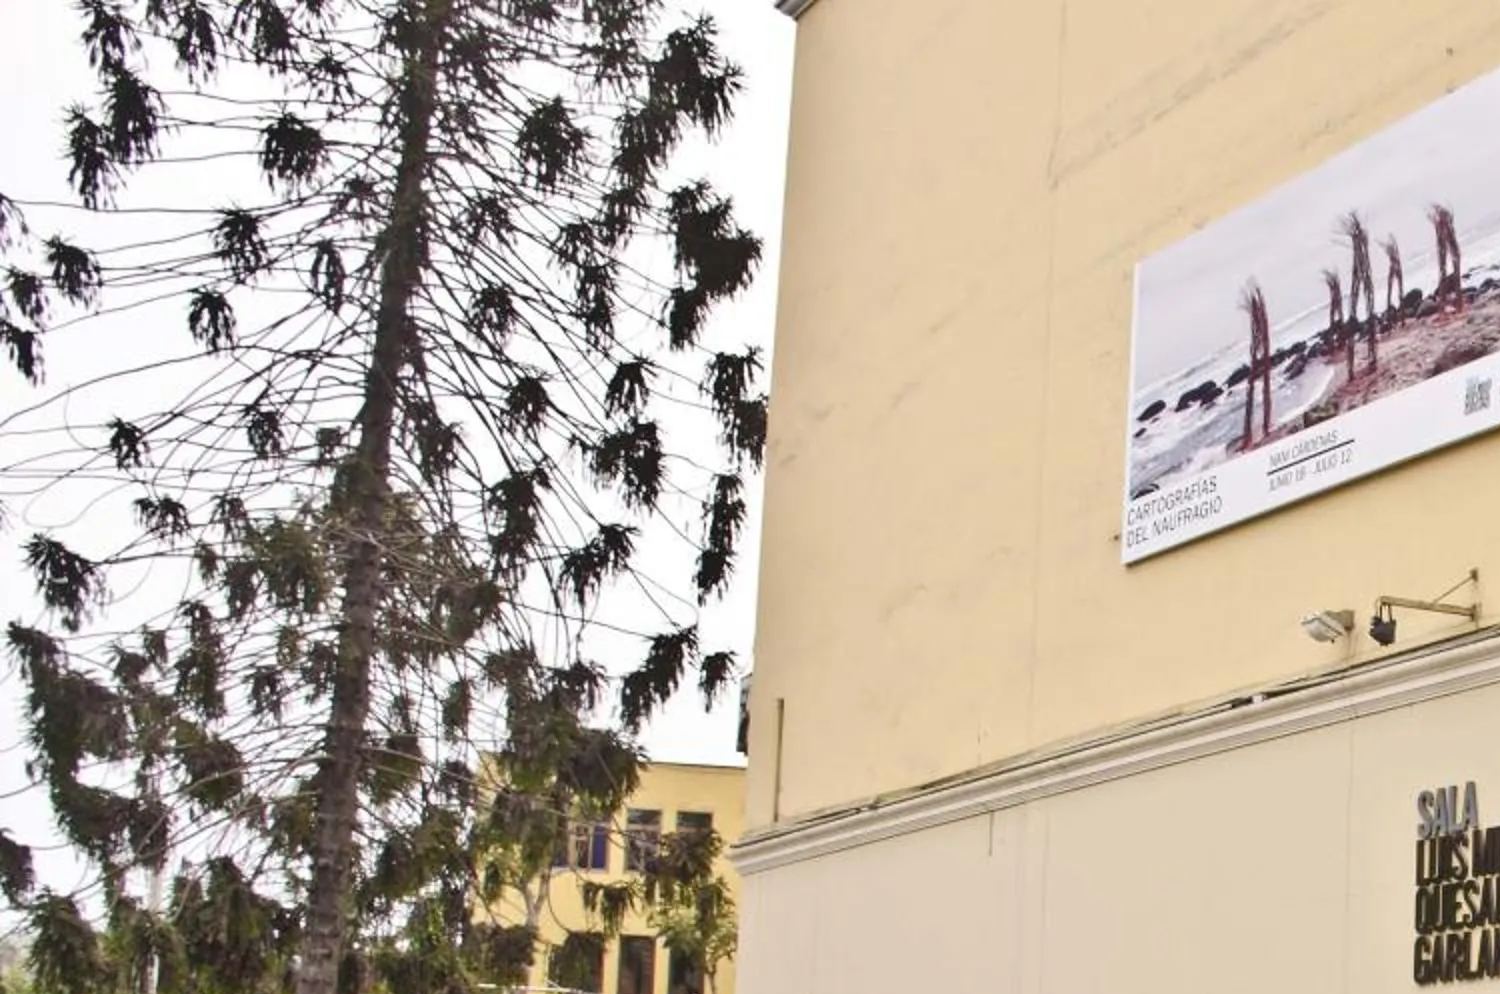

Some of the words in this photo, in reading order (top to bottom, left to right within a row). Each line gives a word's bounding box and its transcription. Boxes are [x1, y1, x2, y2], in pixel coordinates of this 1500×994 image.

[1126, 526, 1149, 548] DEL
[1153, 495, 1223, 536] NAUFRAGIO
[1417, 780, 1479, 840] SALA
[1416, 830, 1469, 886] LUIS
